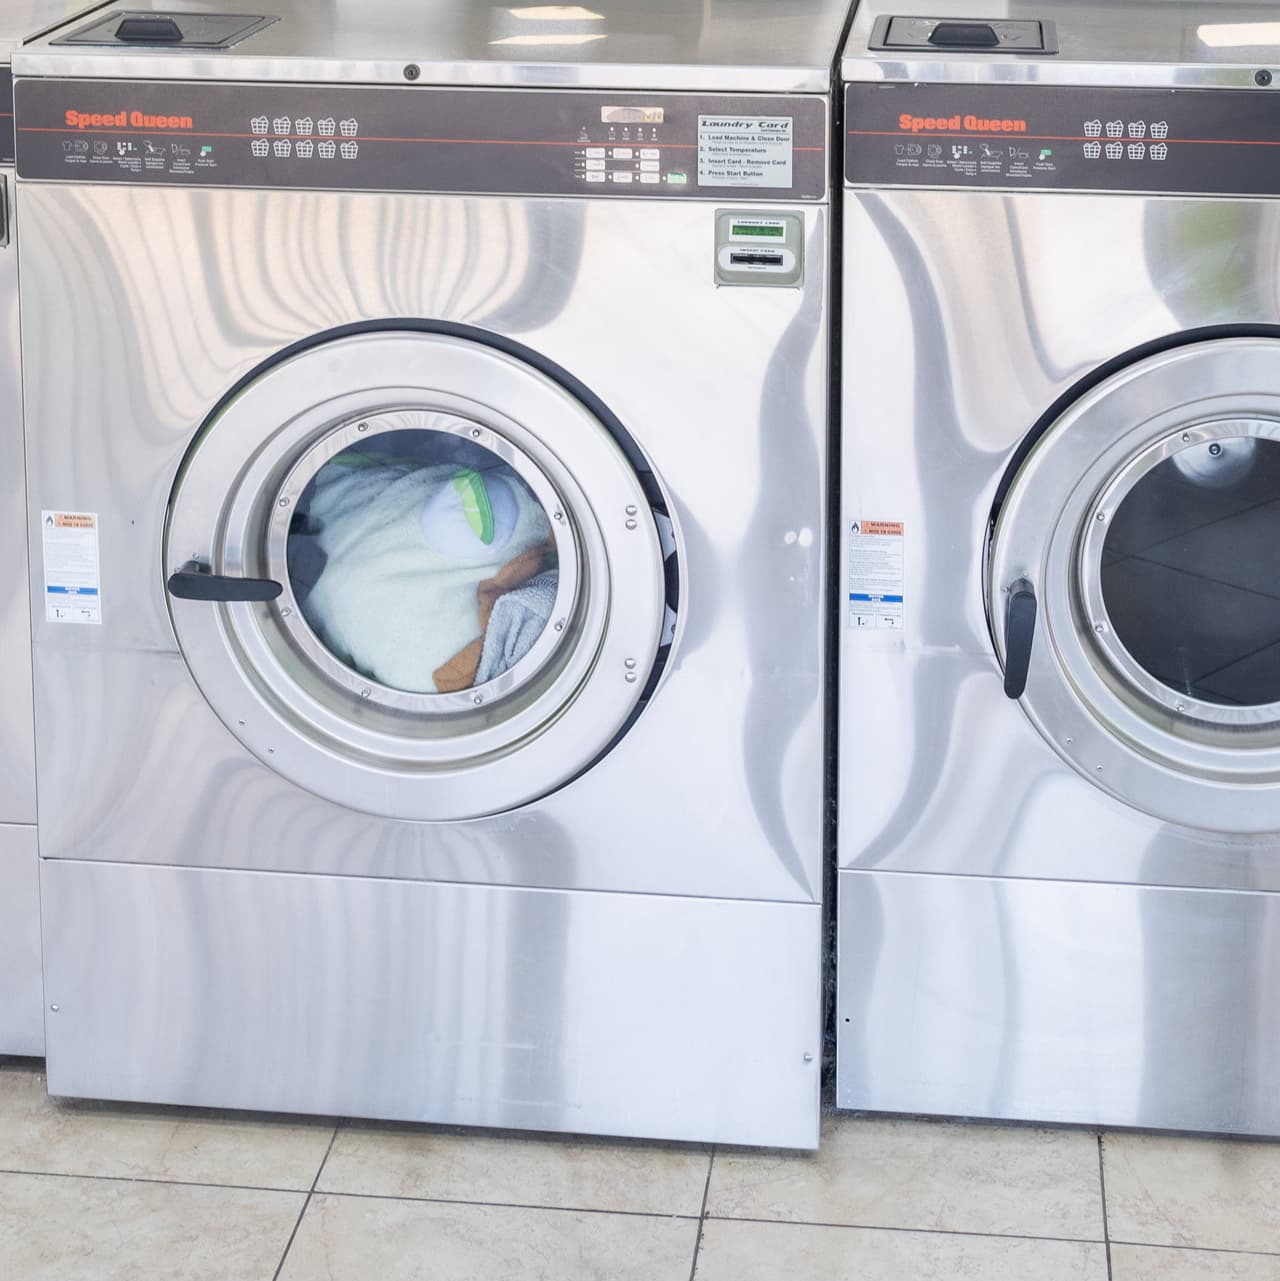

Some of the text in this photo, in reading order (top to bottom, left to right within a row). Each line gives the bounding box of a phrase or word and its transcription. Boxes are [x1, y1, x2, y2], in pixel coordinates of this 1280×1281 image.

[66, 110, 192, 128] Speed Queen
[701, 121, 753, 129] Laundry
[899, 113, 1026, 133] Speed Queen
